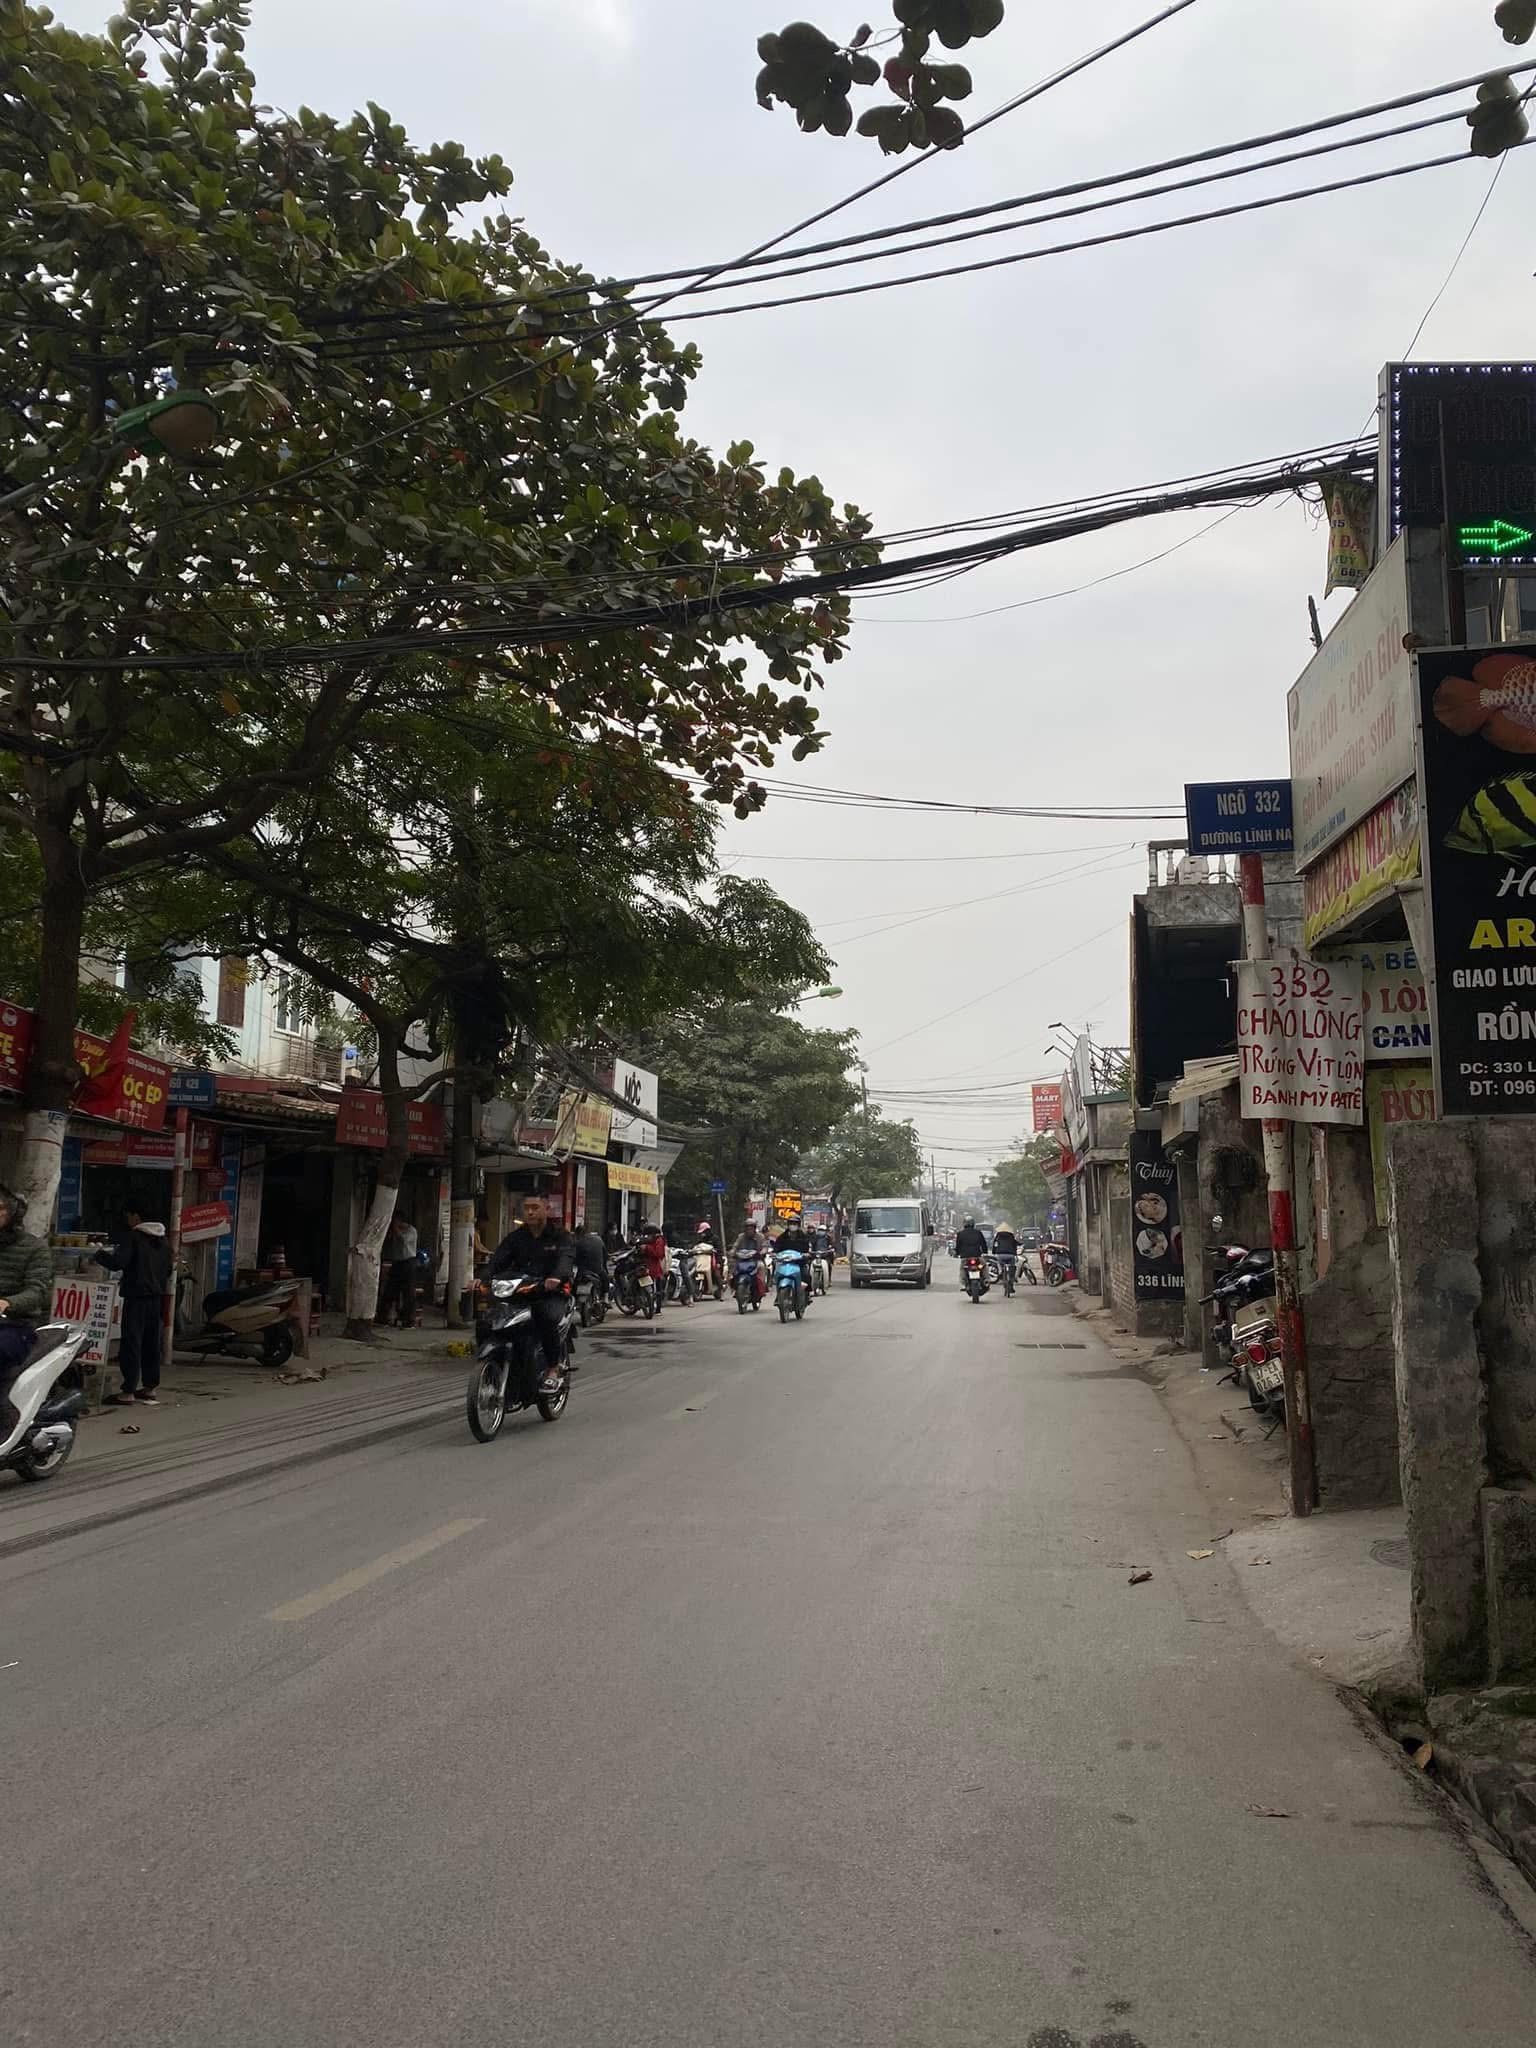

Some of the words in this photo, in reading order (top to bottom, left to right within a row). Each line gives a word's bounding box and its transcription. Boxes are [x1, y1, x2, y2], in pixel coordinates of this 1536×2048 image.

[1217, 789, 1247, 816] NGÕ
[1255, 790, 1281, 813] 332
[1200, 829, 1242, 846] ĐƯỜNG
[1245, 827, 1273, 843] LĨNH
[1276, 828, 1292, 841] NA
[1271, 967, 1334, 998] 332
[1452, 968, 1497, 988] GIAO
[1237, 999, 1297, 1038] CHÁO
[1302, 1000, 1363, 1041] LÒNG
[1239, 1045, 1297, 1075] TRỨNG
[1297, 1047, 1337, 1081] VỊT
[1337, 1050, 1363, 1084] LỘN
[1493, 1062, 1523, 1074] 330
[1252, 1080, 1297, 1105] BÁNH
[1330, 1088, 1362, 1110] PATÊ
[1503, 1079, 1536, 1095] 096
[1137, 1275, 1158, 1287] 336
[54, 1283, 83, 1321] XÔI
